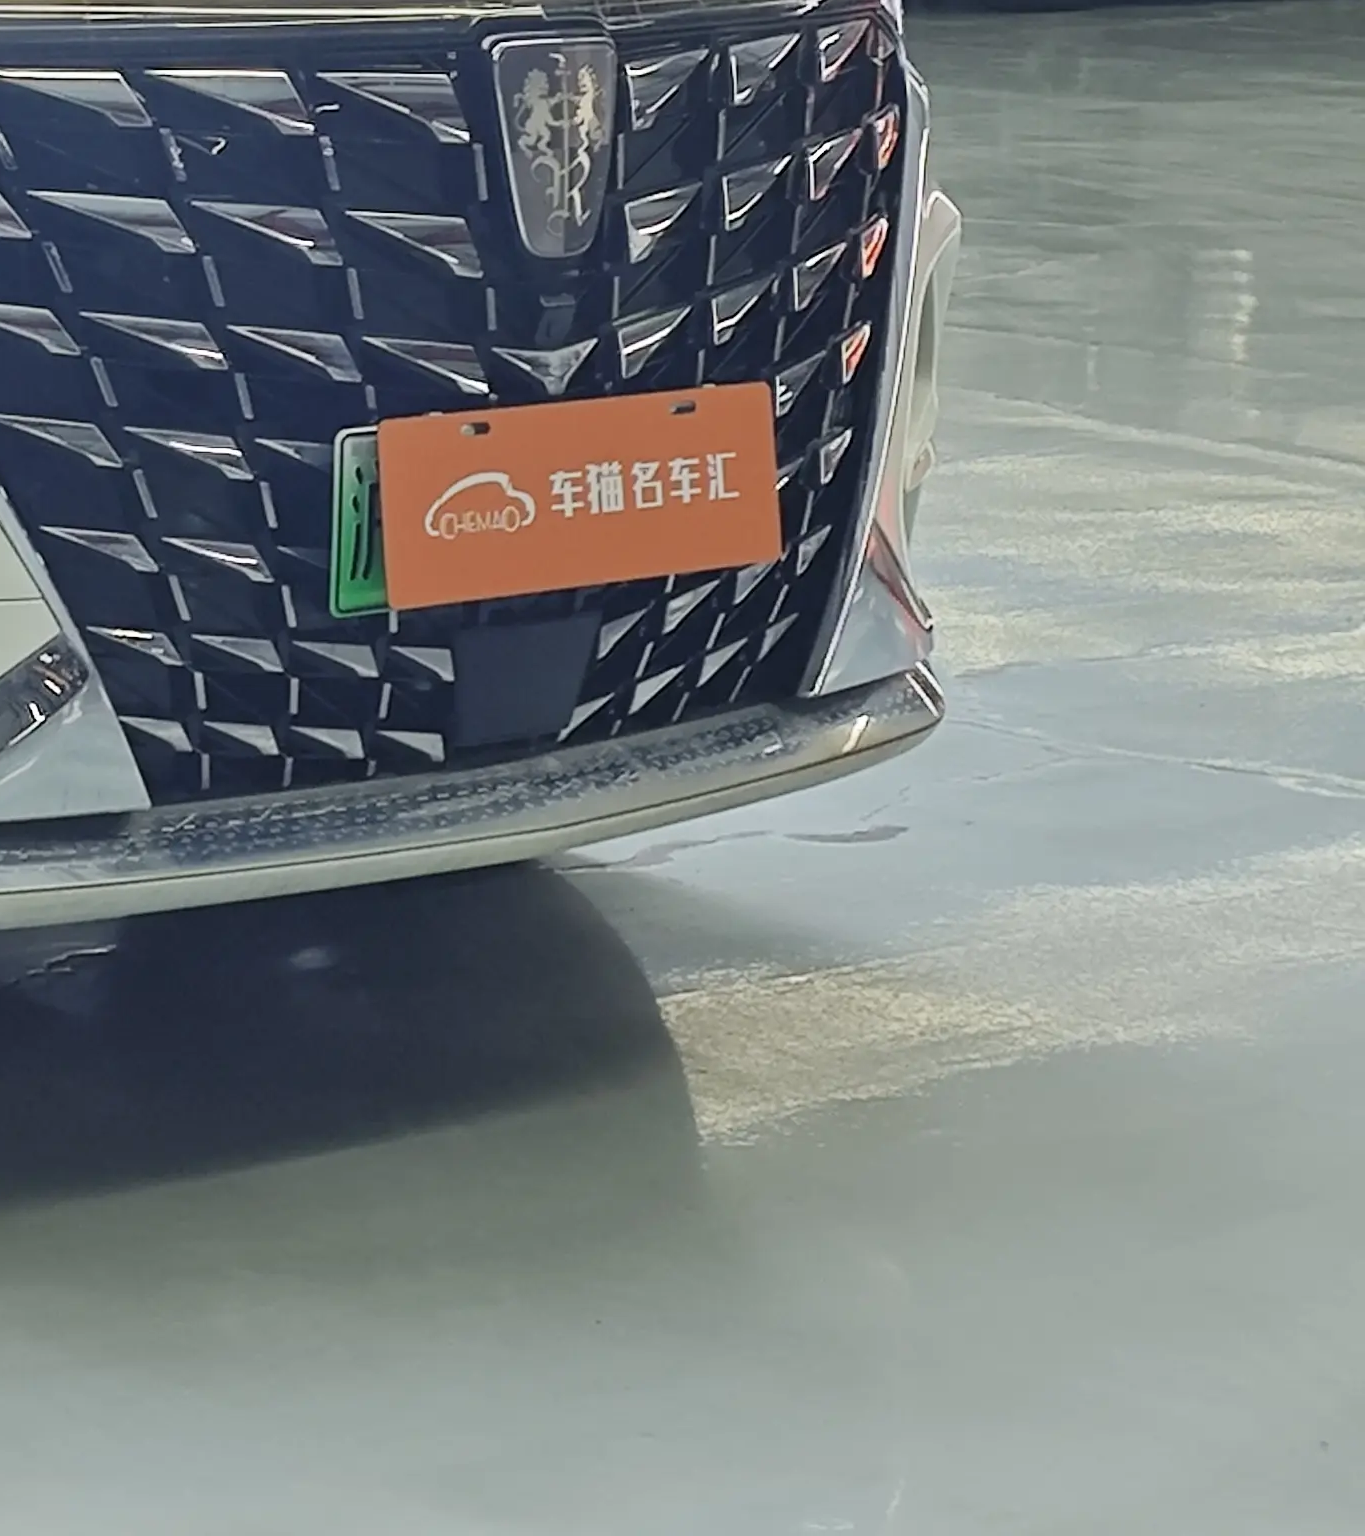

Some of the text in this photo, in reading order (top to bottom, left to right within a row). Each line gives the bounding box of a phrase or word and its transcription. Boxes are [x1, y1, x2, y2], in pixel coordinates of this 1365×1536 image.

[549, 452, 741, 518] 车猫名车汇
[439, 505, 521, 540] CHEMAO
